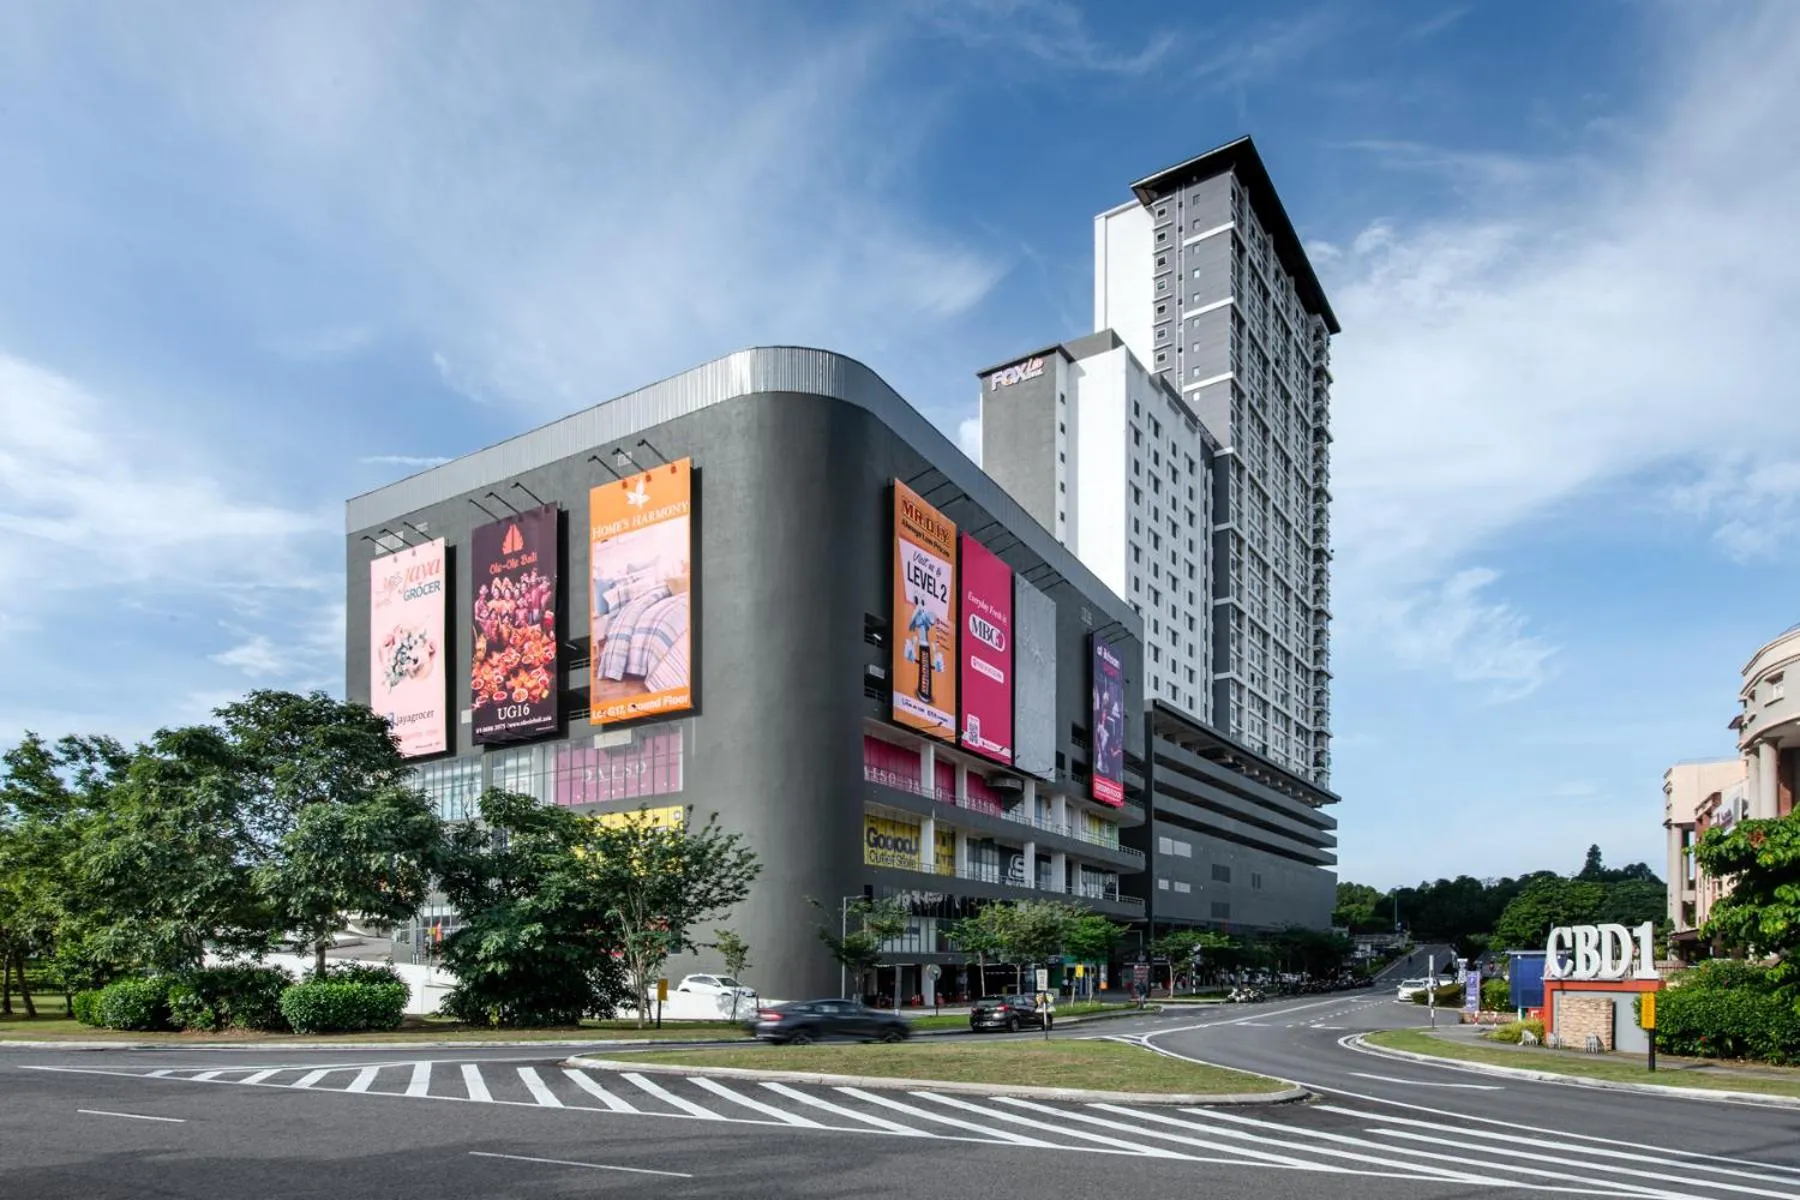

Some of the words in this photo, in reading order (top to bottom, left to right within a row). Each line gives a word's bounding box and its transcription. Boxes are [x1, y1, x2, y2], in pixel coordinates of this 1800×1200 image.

[907, 560, 939, 600] LEVEL
[940, 583, 948, 605] 2
[497, 702, 530, 720] UG16
[1546, 921, 1660, 980] CBD1
